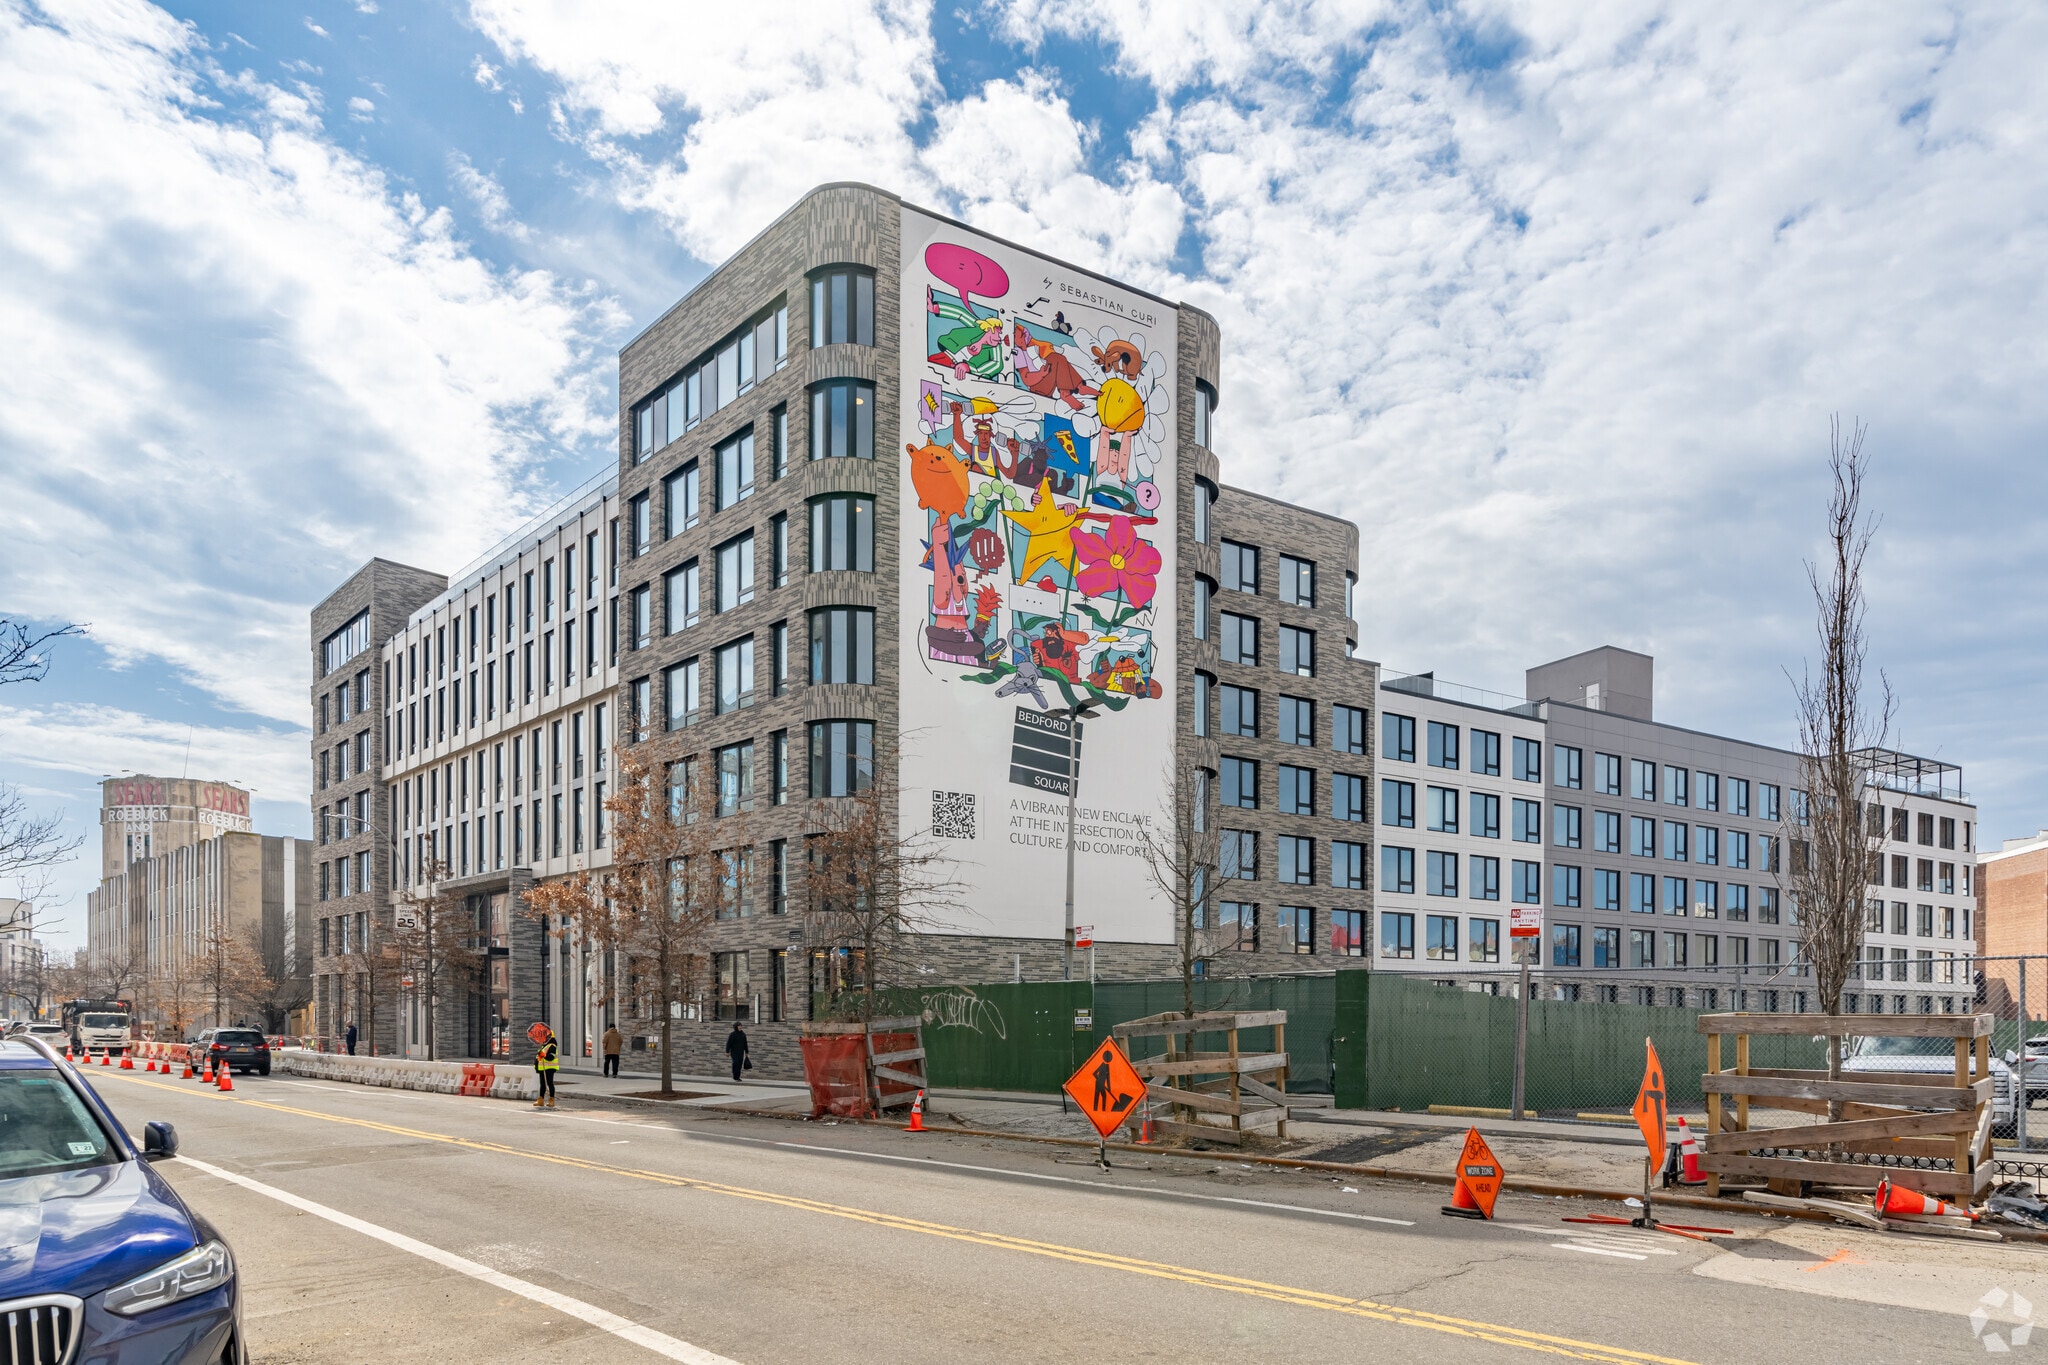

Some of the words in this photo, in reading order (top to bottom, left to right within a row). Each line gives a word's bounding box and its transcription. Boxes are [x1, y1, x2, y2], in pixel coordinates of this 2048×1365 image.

[1043, 277, 1053, 289] by
[1060, 283, 1124, 313] SEBASTIAN
[1131, 309, 1157, 325] CURI
[1018, 711, 1068, 732] BEDFORD
[115, 781, 163, 805] SEARS
[1034, 775, 1069, 793] SQUAR
[204, 786, 247, 815] SEARS
[108, 809, 168, 821] ROEBUCK
[199, 811, 252, 832] ROEBUCK
[1010, 799, 1018, 810] A
[1021, 799, 1069, 816] VIBRANT
[1074, 807, 1101, 820] NEW
[1103, 811, 1151, 826] ENCLAVE
[126, 823, 151, 832] AND
[1010, 816, 1024, 827] AT
[1026, 817, 1050, 831] THE
[1009, 832, 1063, 849] CULTURE
[1093, 843, 1148, 858] COMFORT
[1511, 909, 1520, 917] NO
[397, 918, 415, 928] 25
[1466, 1166, 1480, 1175] WORK
[1481, 1166, 1494, 1176] ZONE
[1476, 1183, 1492, 1193] AHEAD
